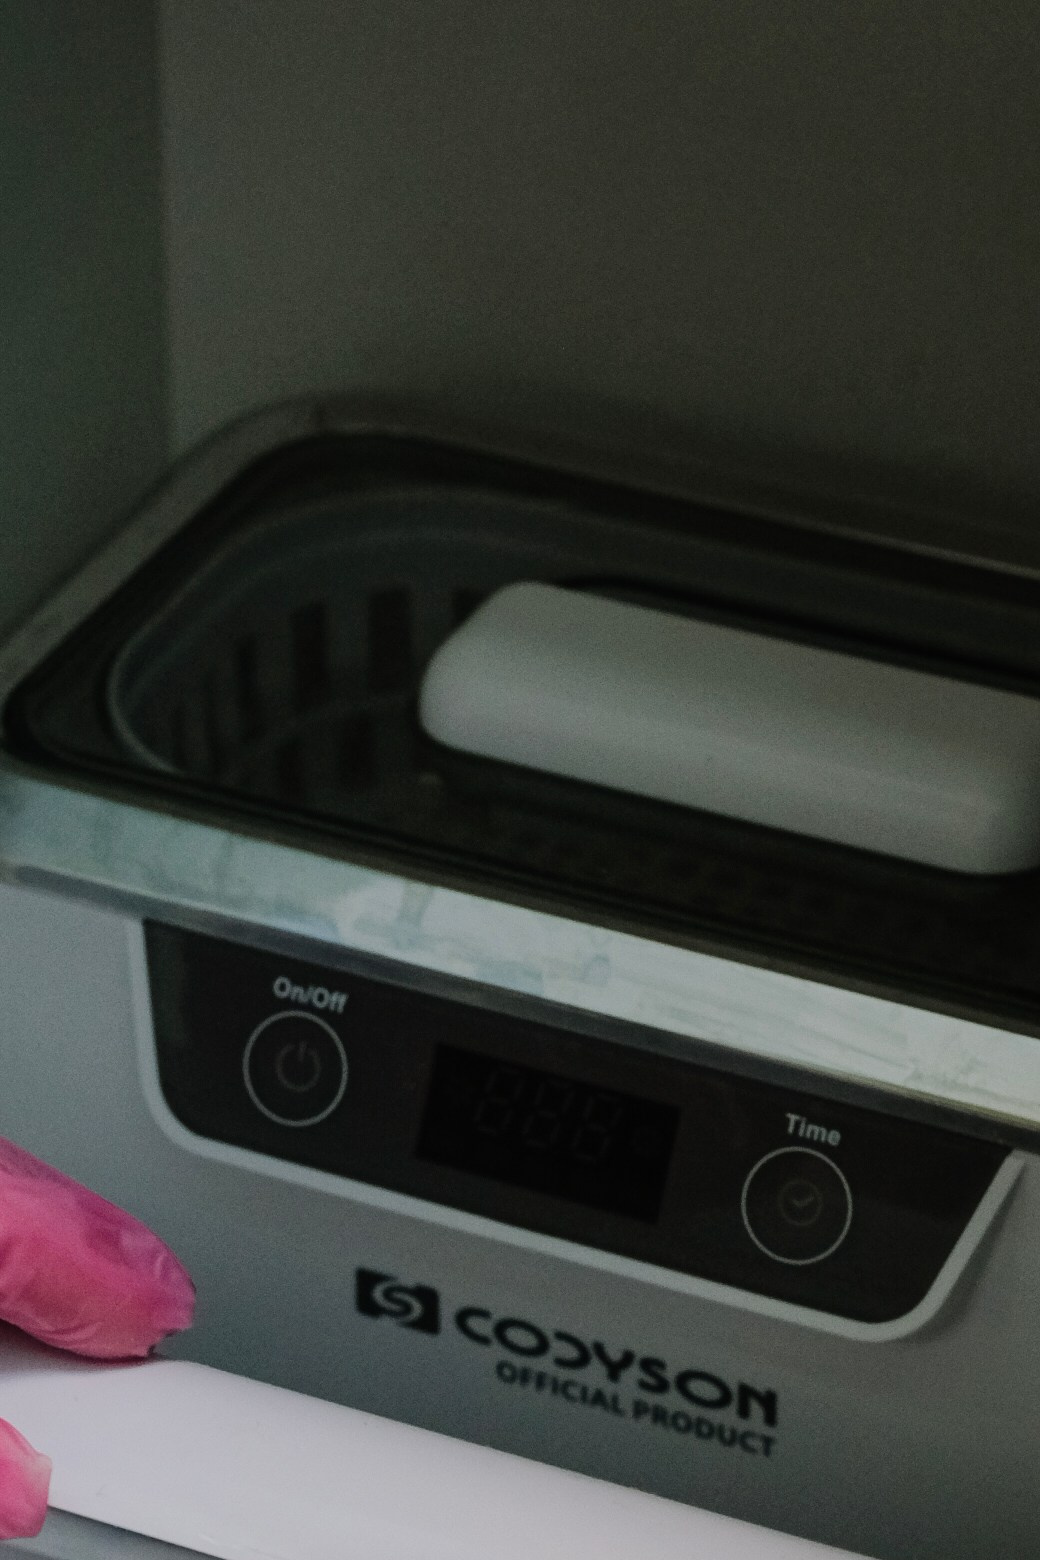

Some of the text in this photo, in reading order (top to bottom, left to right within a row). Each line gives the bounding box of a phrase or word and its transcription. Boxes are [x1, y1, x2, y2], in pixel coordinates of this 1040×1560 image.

[273, 976, 348, 1014] On/Off
[785, 1113, 841, 1146] Time
[454, 1306, 778, 1427] CODYSON
[496, 1360, 777, 1457] OFFICIAL PRODUCT
